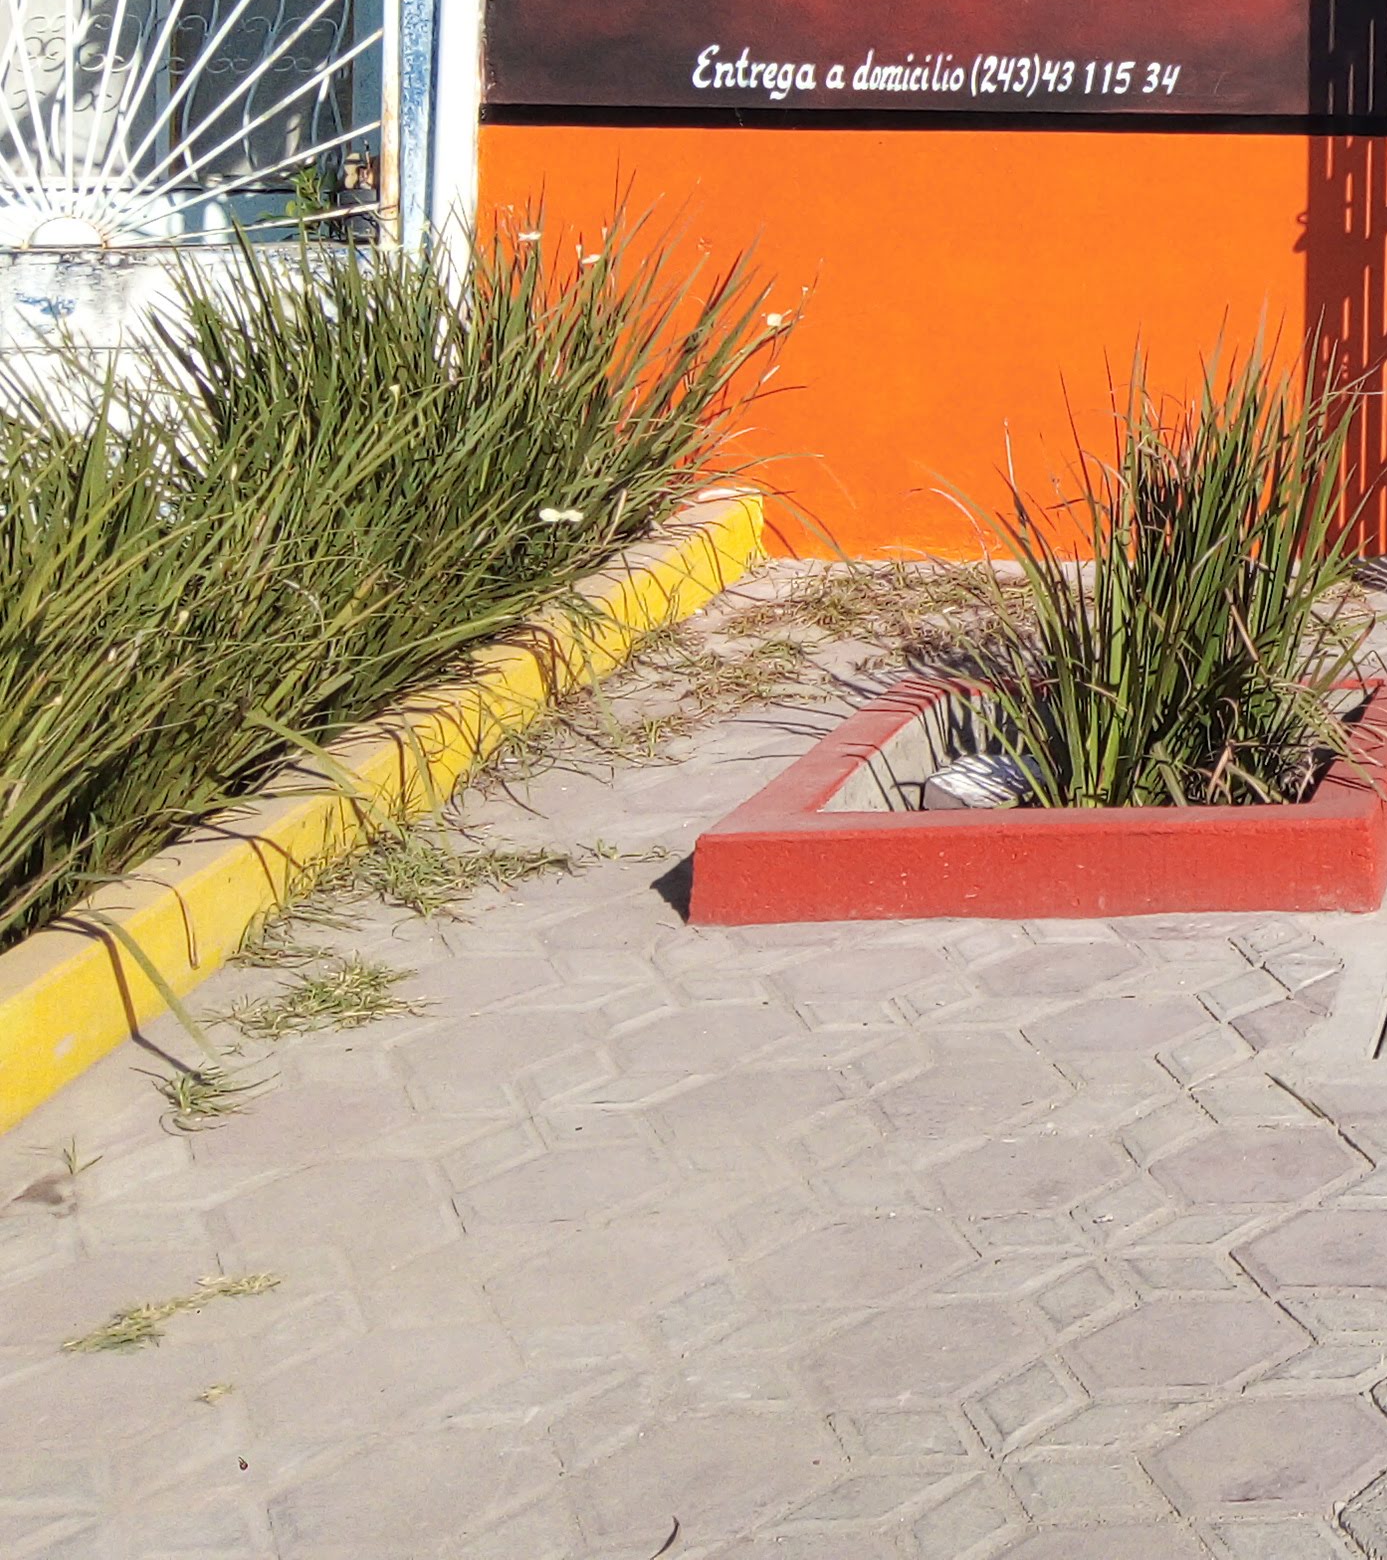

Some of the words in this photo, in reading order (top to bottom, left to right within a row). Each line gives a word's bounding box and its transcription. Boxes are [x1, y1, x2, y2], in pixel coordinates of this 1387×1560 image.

[691, 43, 817, 101] Entrega
[825, 64, 846, 90] a
[852, 48, 965, 92] domicilio
